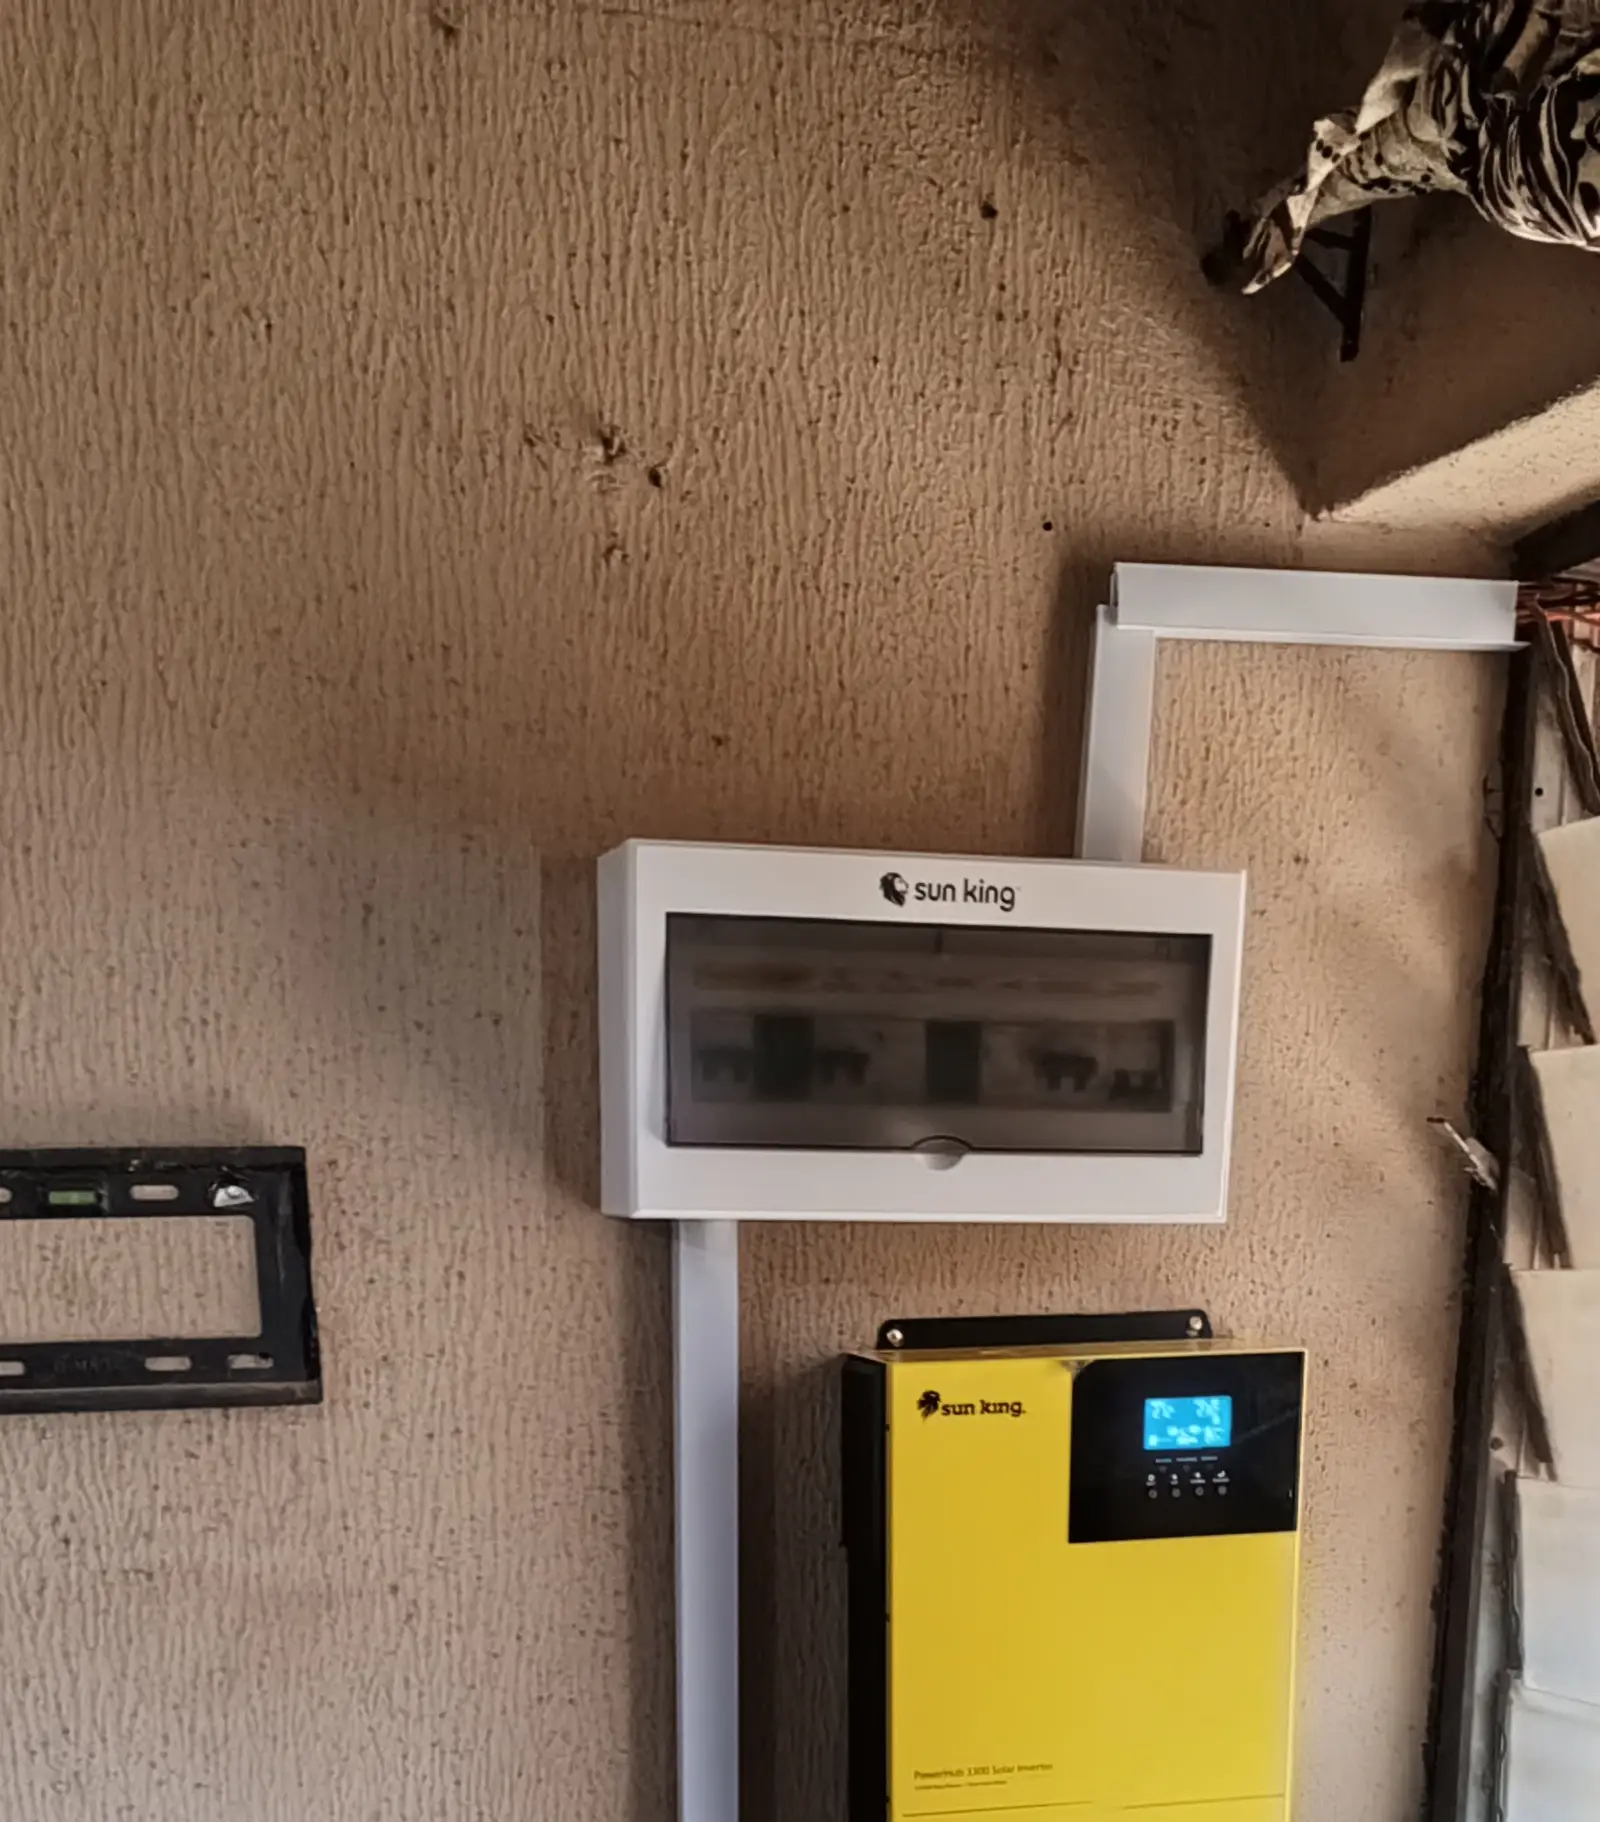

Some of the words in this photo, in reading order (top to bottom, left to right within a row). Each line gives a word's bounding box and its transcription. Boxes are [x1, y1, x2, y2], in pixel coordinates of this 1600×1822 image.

[914, 882, 956, 902] sun
[963, 878, 1016, 912] king
[941, 1403, 976, 1416] sun
